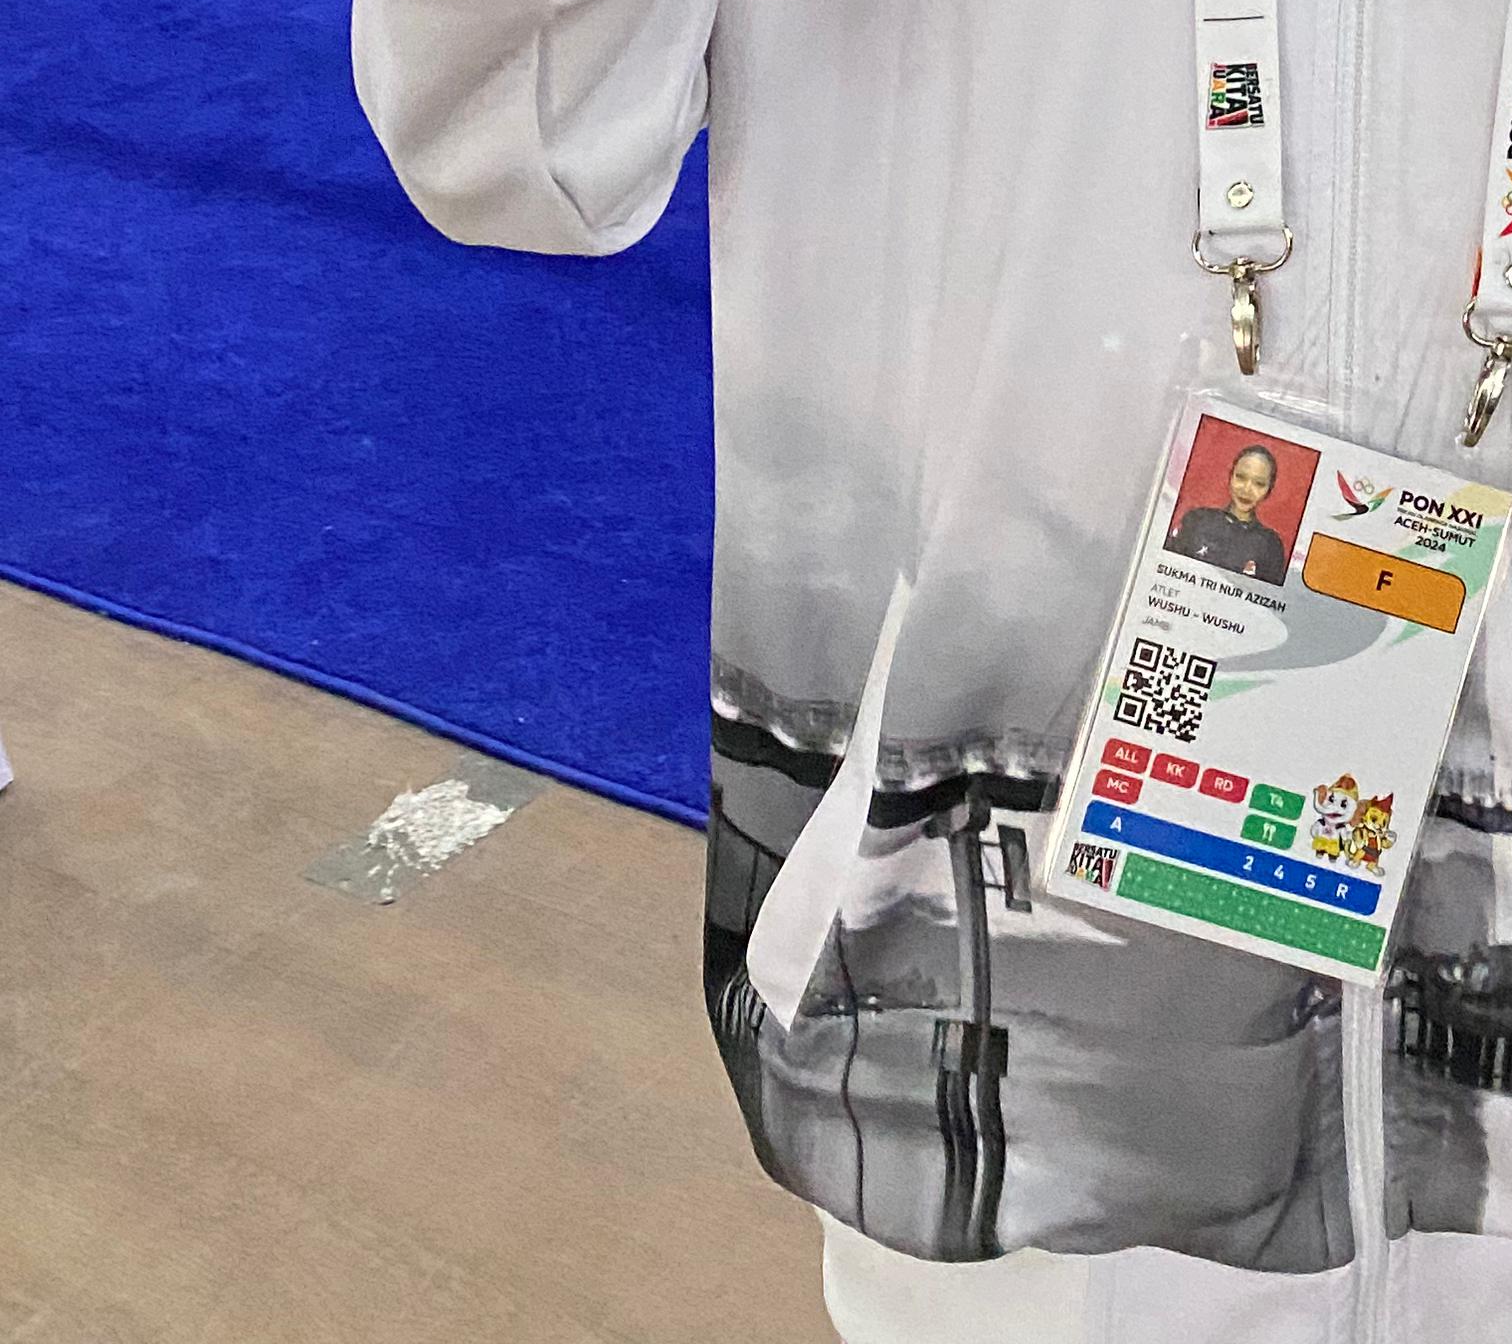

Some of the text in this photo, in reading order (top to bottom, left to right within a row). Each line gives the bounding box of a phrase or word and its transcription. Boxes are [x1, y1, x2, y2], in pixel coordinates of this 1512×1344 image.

[1400, 490, 1446, 518] PON
[1447, 504, 1484, 530] XXI
[1393, 516, 1476, 548] ACEH-SUMUT
[1415, 536, 1447, 553] 2024
[1157, 563, 1287, 614] SUKMA TRI NUR AZIZAH
[1376, 569, 1394, 591] F
[1150, 583, 1181, 599] ATLET
[1149, 596, 1191, 618] WUSHU
[1202, 611, 1246, 635] WUSHU
[1114, 746, 1140, 764] ALL
[1165, 762, 1185, 778] KK
[1106, 777, 1129, 794] MC
[1214, 776, 1234, 792] RD
[1110, 816, 1349, 900] A 2 4 5 R
